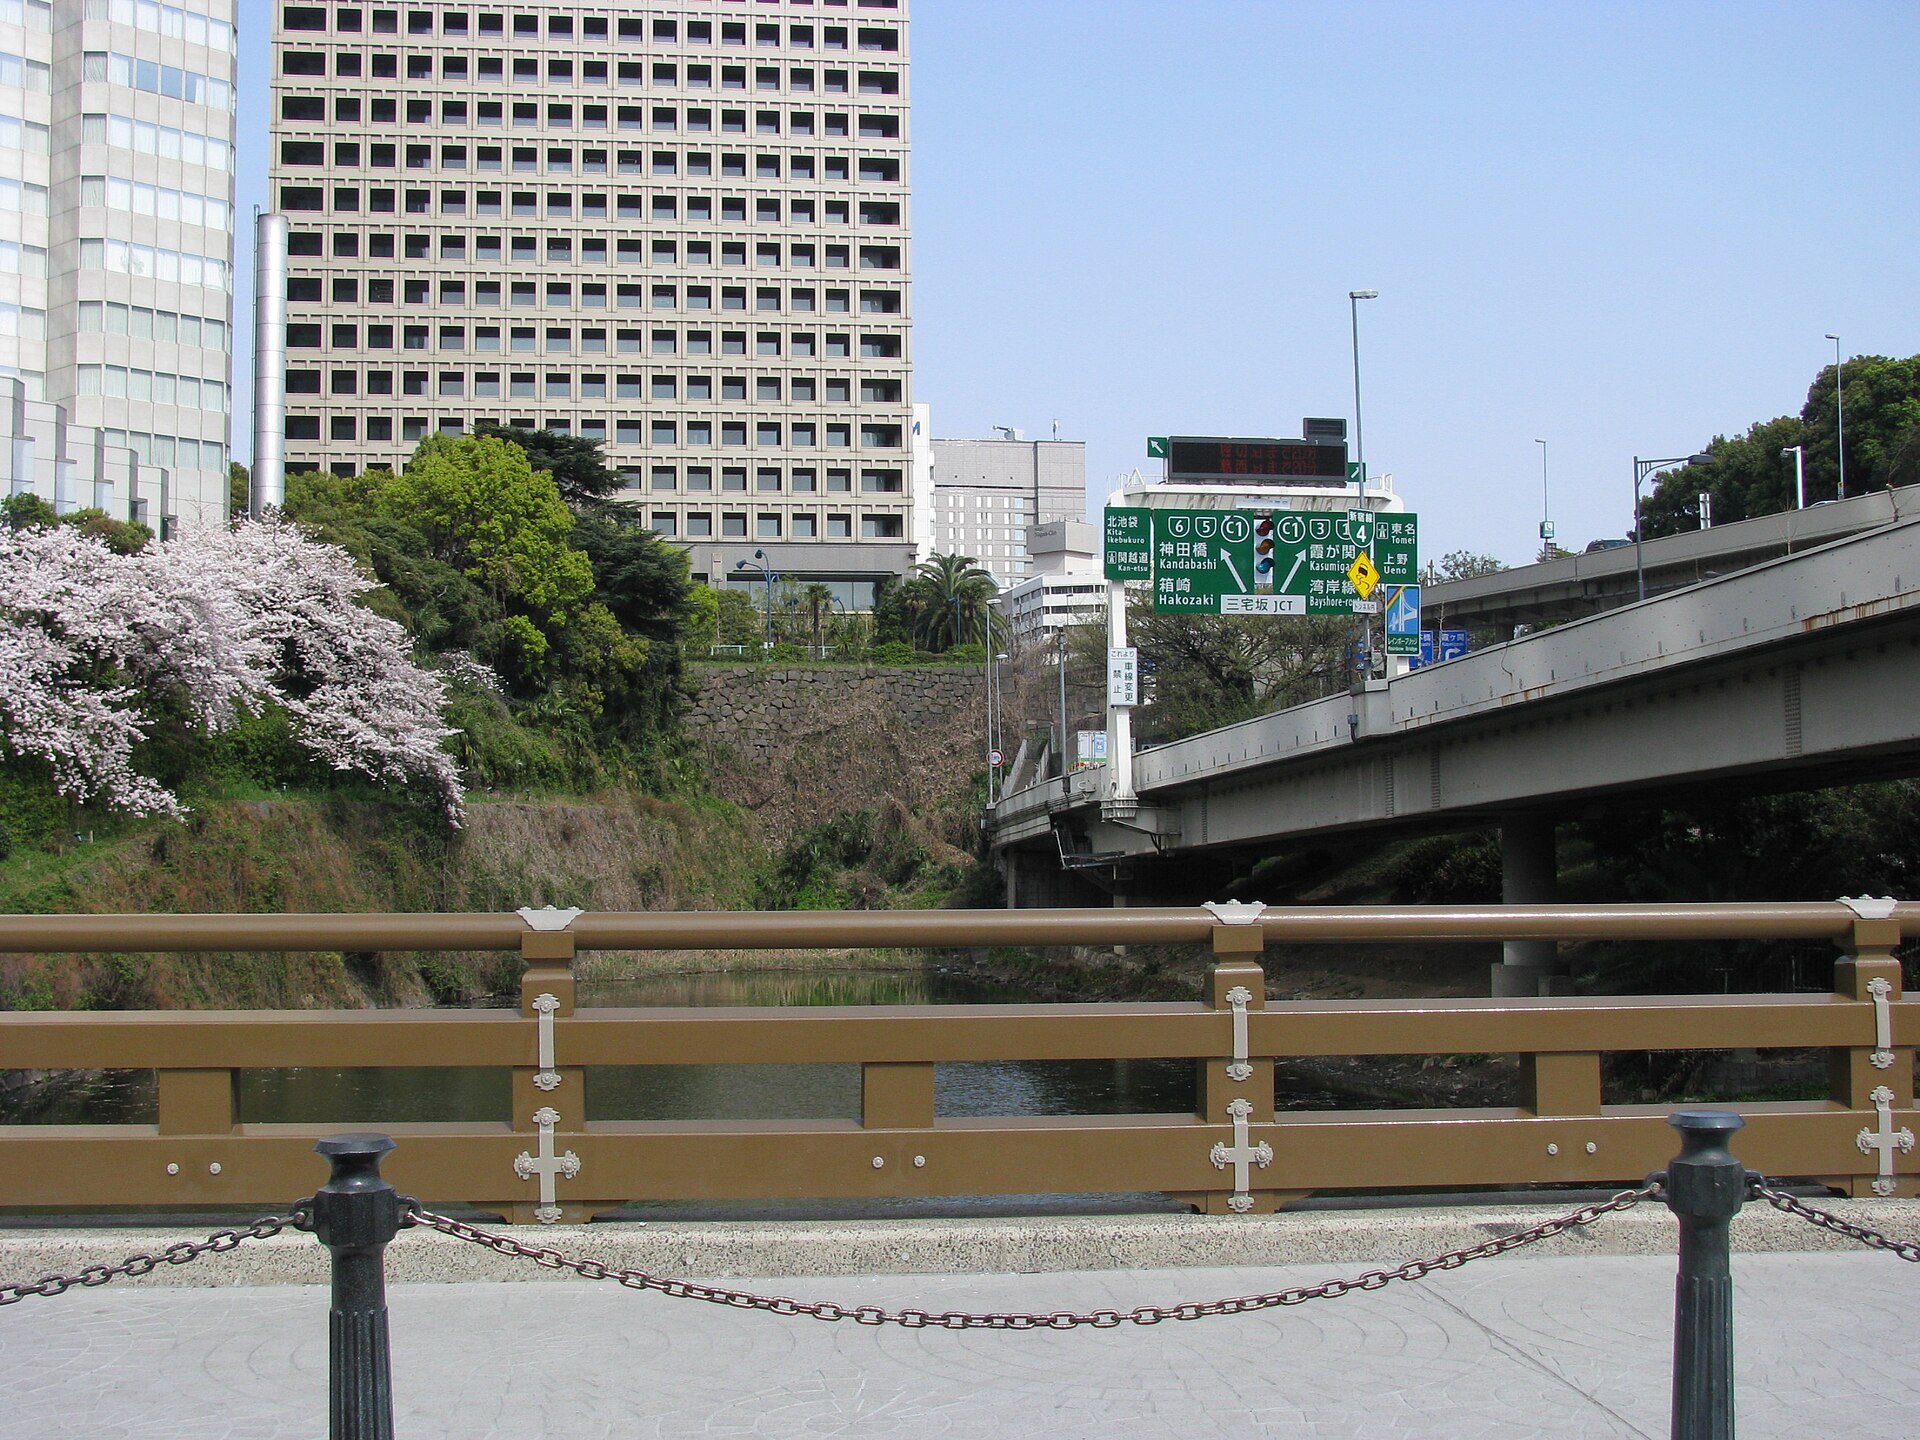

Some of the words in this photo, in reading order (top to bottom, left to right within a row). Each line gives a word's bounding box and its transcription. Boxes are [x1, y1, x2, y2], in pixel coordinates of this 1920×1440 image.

[1107, 515, 1138, 528] 北池袋
[1349, 511, 1373, 524] 新宿線
[1175, 519, 1184, 533] 6
[1202, 520, 1211, 533] 5
[1225, 521, 1243, 537] C1
[1282, 522, 1299, 538] C1
[1316, 523, 1325, 535] 3
[1391, 523, 1415, 535] 東名
[1356, 524, 1367, 542] 4
[1107, 536, 1145, 544] ikebukuro
[1391, 536, 1416, 544] Tomei
[1159, 542, 1208, 558] 神田橋
[1310, 544, 1356, 560] 霞が関
[1117, 551, 1149, 564] 関越道
[1159, 558, 1217, 570] Kandabashi
[1383, 553, 1409, 566] 上野
[1309, 560, 1354, 574] Kasumiga
[1383, 566, 1407, 575] Ueno
[1159, 577, 1191, 593] 箱崎
[1309, 579, 1356, 595] 湾岸線
[1159, 594, 1214, 606] Hakozaki
[1226, 598, 1268, 611] 三宅坂
[1273, 600, 1293, 611] JCT
[1309, 596, 1365, 609] Bayshore-ro
[1113, 669, 1122, 694] 禁止
[1124, 662, 1134, 702] 車線変更
